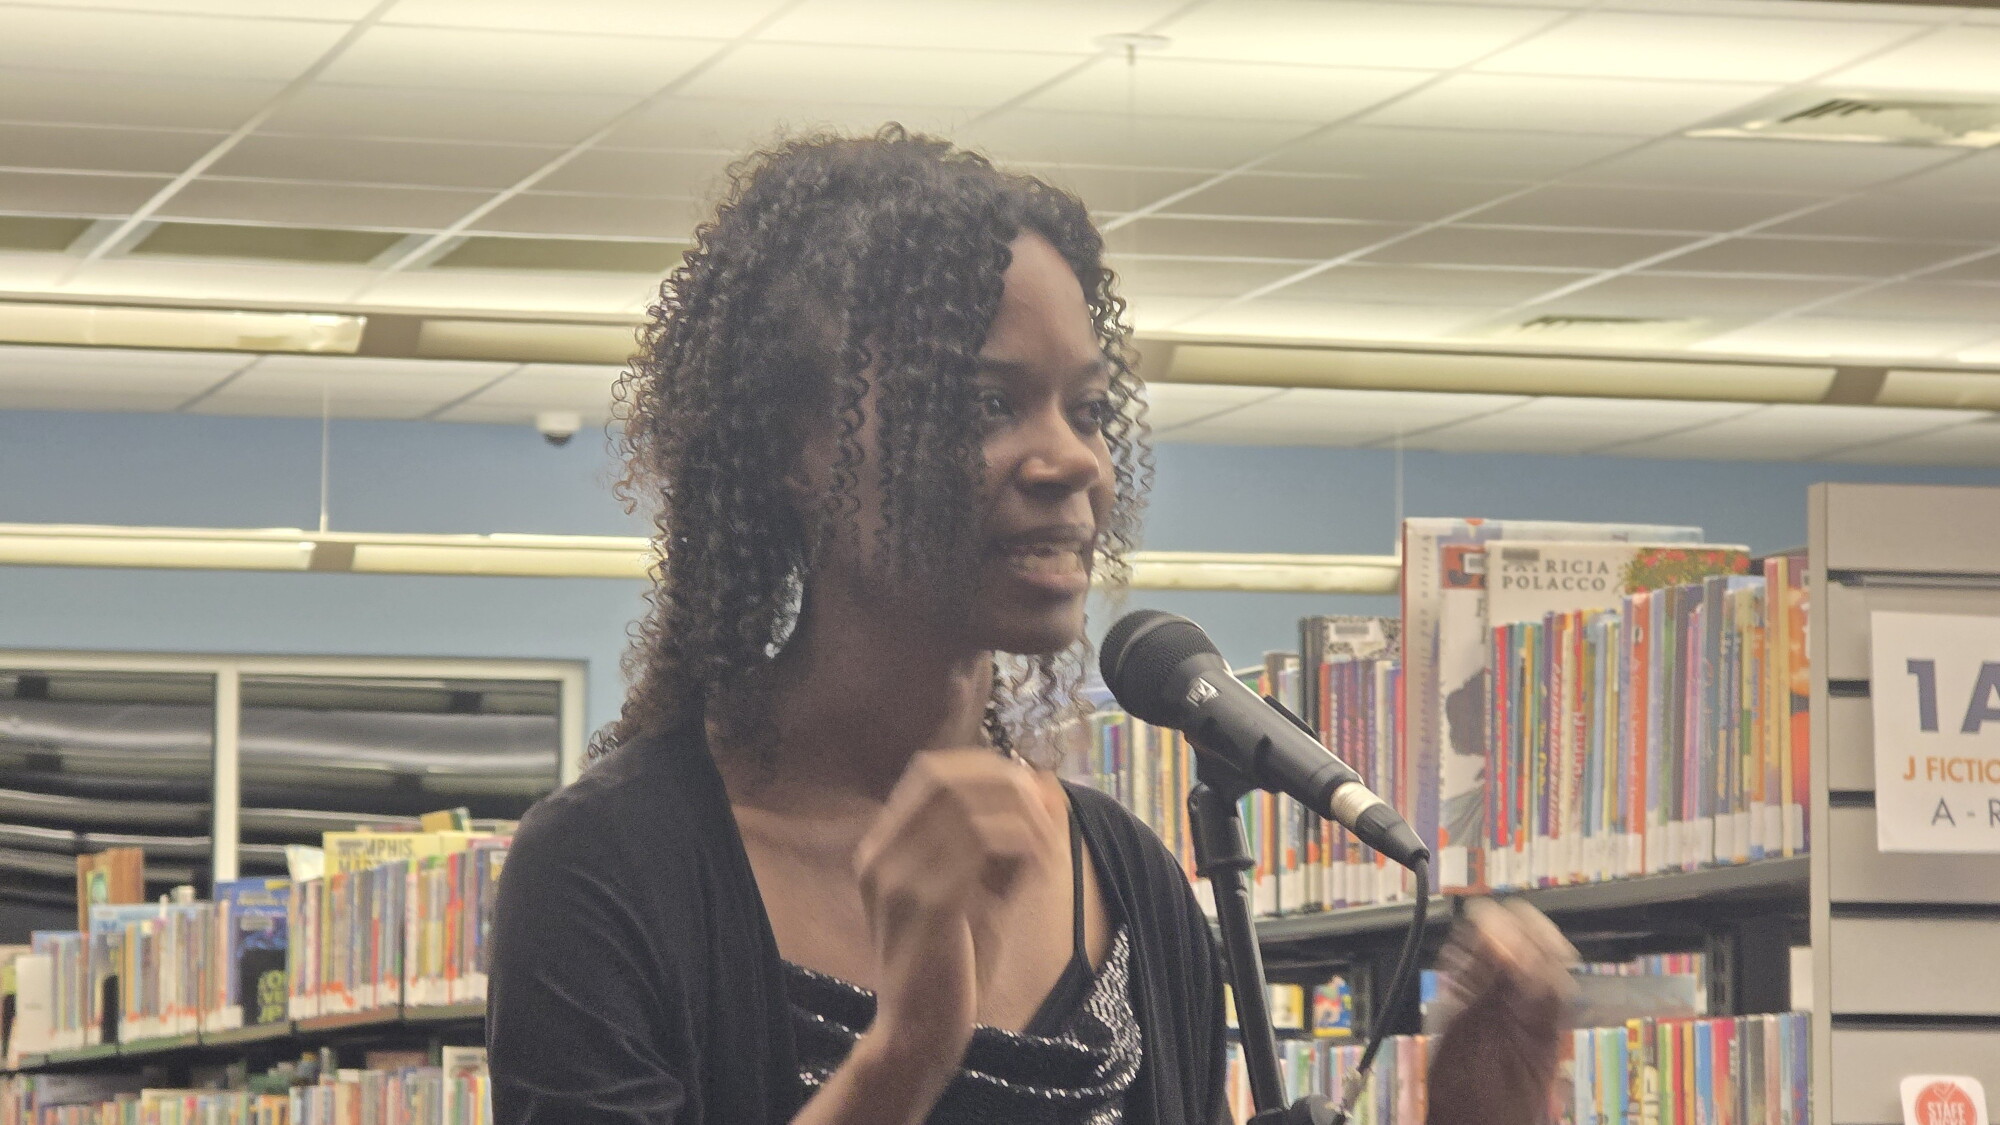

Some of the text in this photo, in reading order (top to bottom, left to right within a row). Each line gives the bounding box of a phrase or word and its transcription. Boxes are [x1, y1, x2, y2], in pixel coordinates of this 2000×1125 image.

[1502, 560, 1609, 574] ARICIA
[1502, 575, 1606, 591] POLACCO
[1906, 658, 2000, 734] 1A
[1903, 756, 1916, 781] J
[1931, 798, 1956, 826] A
